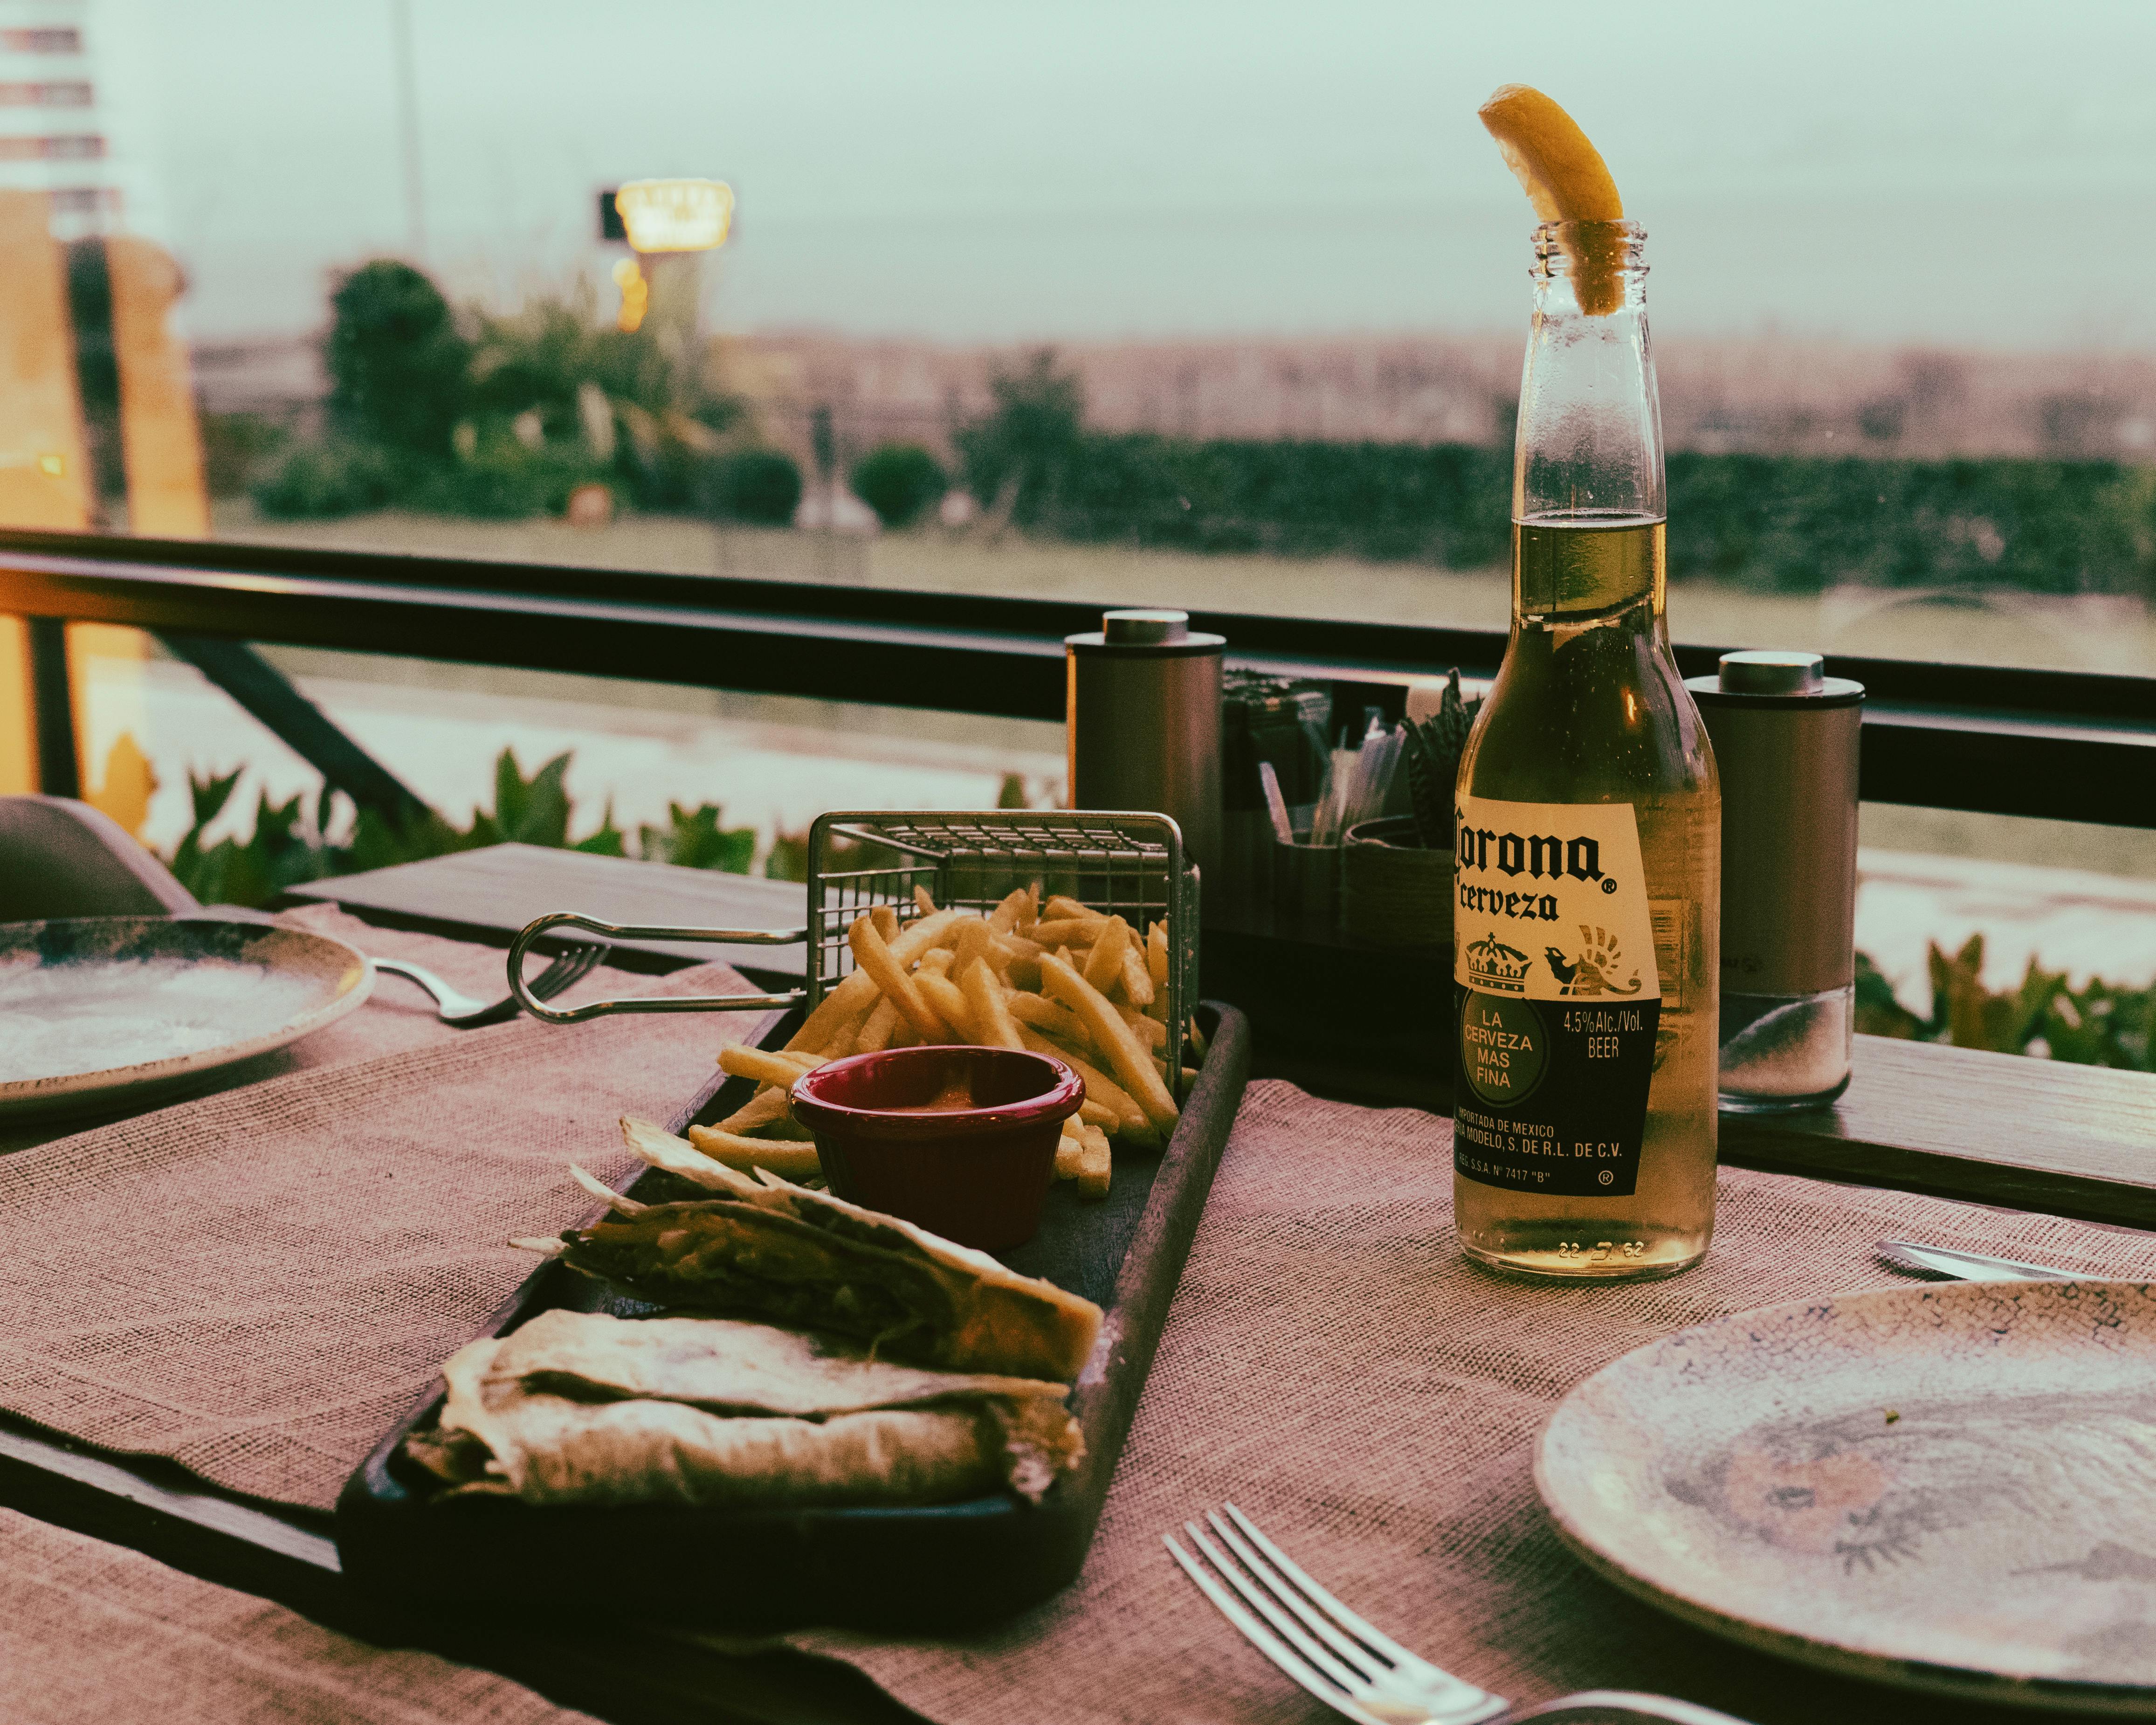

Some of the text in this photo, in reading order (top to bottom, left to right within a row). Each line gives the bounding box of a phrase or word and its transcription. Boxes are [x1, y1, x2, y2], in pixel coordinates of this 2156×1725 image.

[1454, 806, 1605, 882] Corona
[1460, 883, 1560, 922] cerveza
[1482, 1009, 1502, 1028] LA
[1465, 1024, 1533, 1051] CERVEZA
[1589, 1036, 1619, 1058] BEER
[1477, 1047, 1510, 1068] MAS
[1477, 1066, 1511, 1088] FINA
[1459, 1106, 1554, 1138] IMPORTADA DE MEXICO
[1467, 1126, 1505, 1152] MODELO,
[1508, 1136, 1518, 1152] S.
[1522, 1138, 1538, 1154] DE
[1543, 1141, 1569, 1157] R.L.
[1575, 1143, 1592, 1157] DE
[1598, 1143, 1622, 1157] C.V.
[1506, 1167, 1528, 1180] 7417
[1532, 1171, 1550, 1183] "B"
[1559, 1242, 1579, 1258] 22
